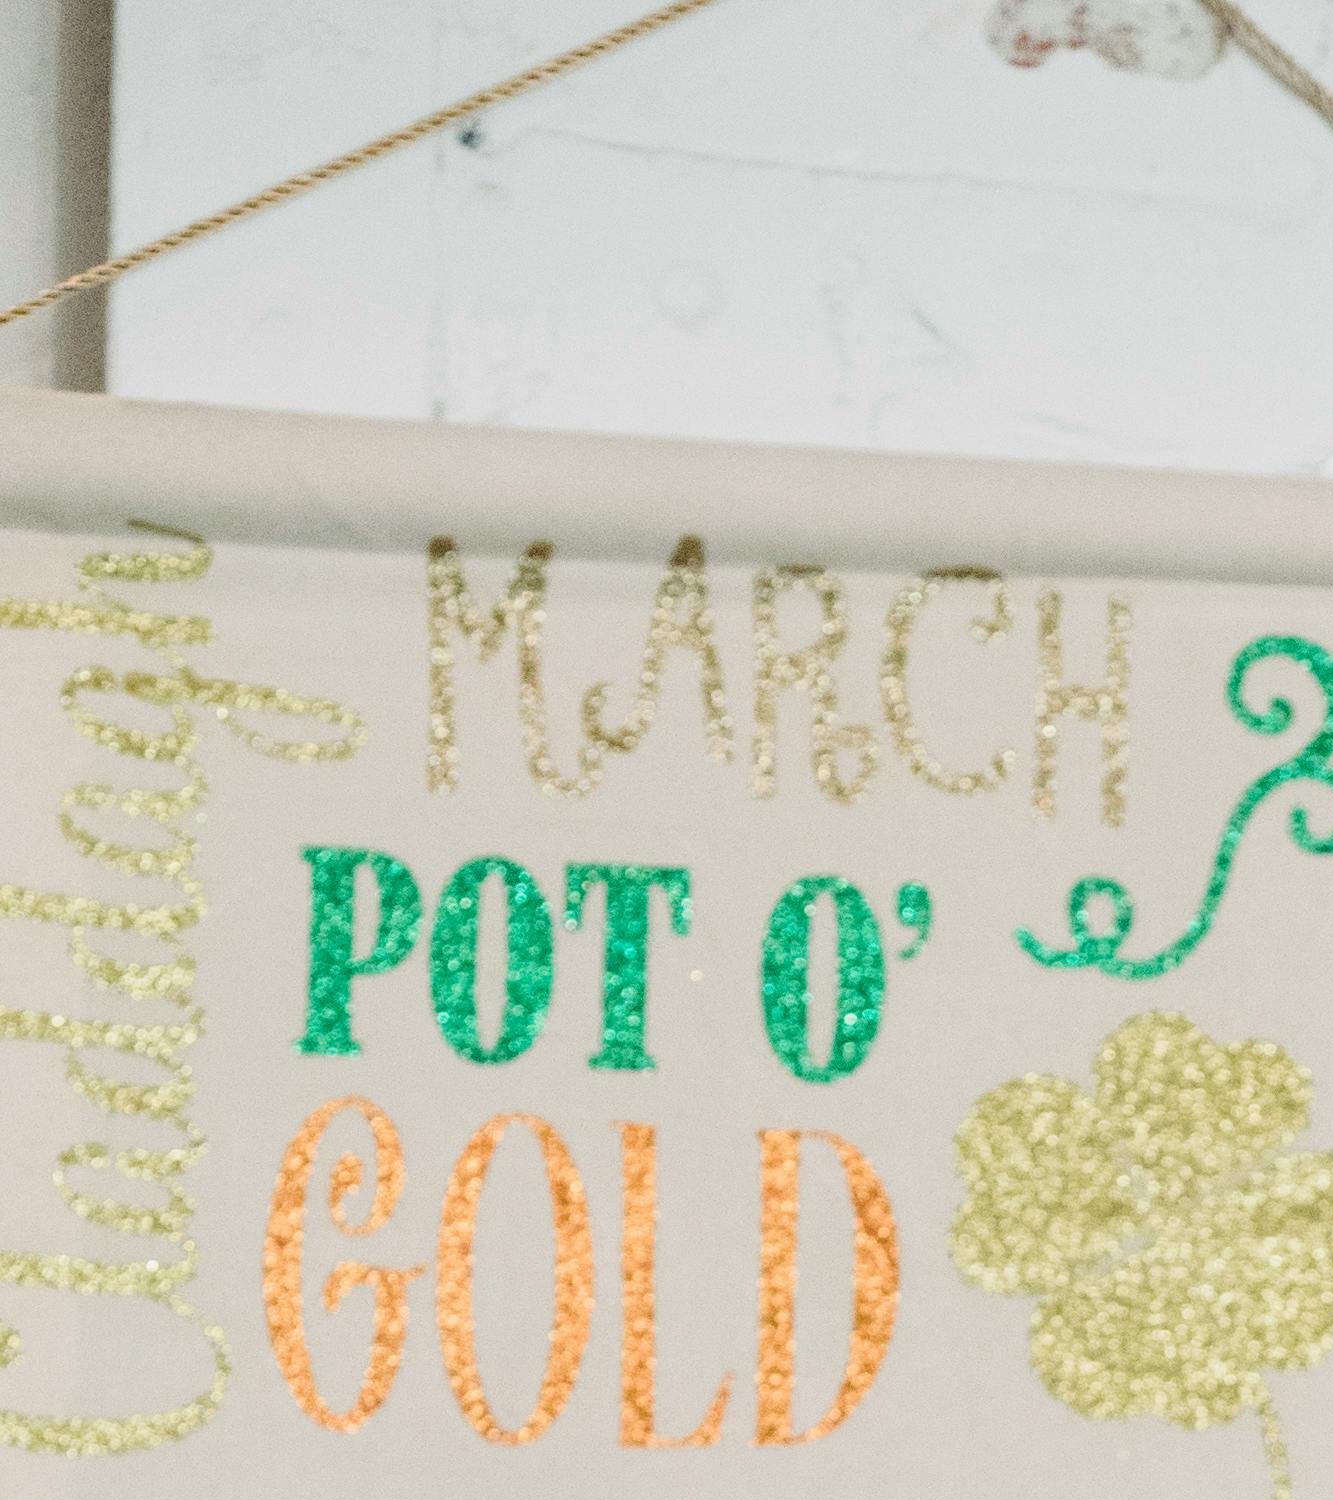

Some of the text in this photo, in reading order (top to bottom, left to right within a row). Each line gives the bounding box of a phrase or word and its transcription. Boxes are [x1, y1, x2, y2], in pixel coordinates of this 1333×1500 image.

[424, 536, 1137, 828] MARCH
[293, 845, 932, 1084] POT O'
[263, 1095, 902, 1450] GOLD
